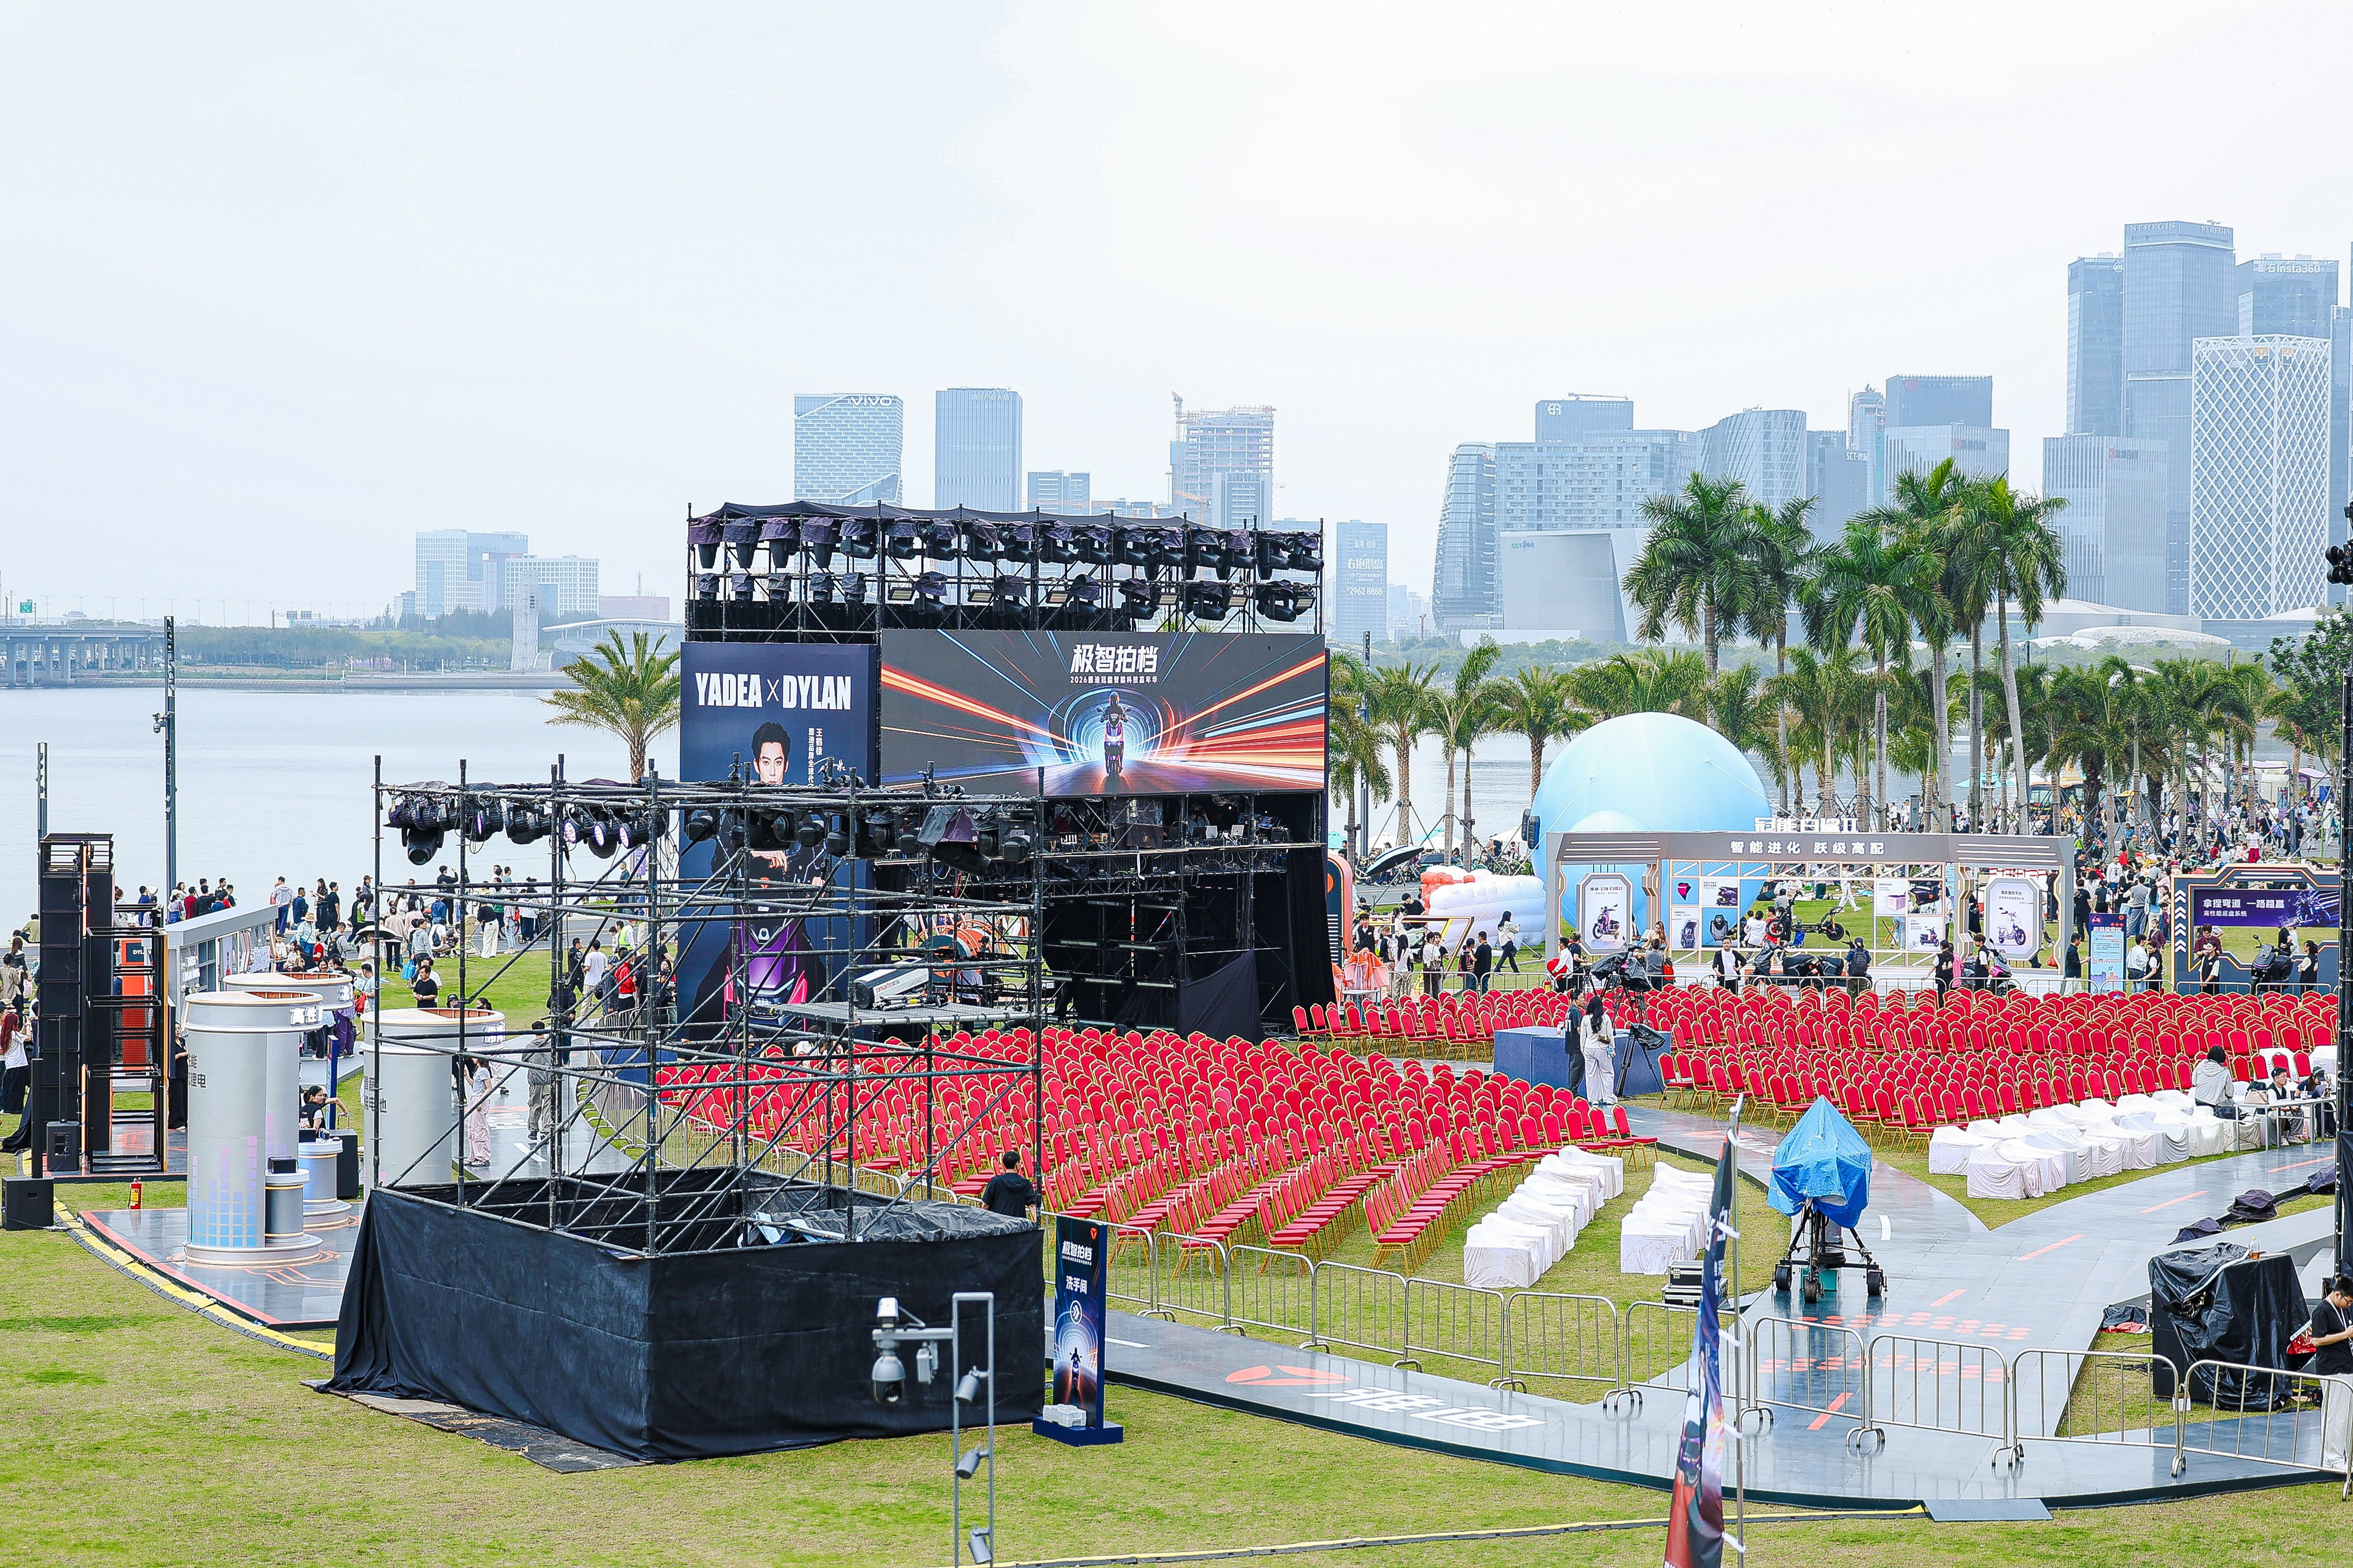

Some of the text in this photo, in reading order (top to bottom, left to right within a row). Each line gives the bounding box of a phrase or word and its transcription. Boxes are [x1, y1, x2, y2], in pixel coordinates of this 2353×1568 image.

[1070, 643, 1159, 673] 极智拍档
[695, 672, 762, 708] YADEA
[782, 675, 851, 710] DYLAN
[1730, 840, 1884, 855] 智能进化 跃级高配
[2203, 899, 2285, 909] 拿捏弯道 一路稳赢
[1062, 1240, 1092, 1261] 极智拍档
[1066, 1275, 1087, 1294] 洗手间
